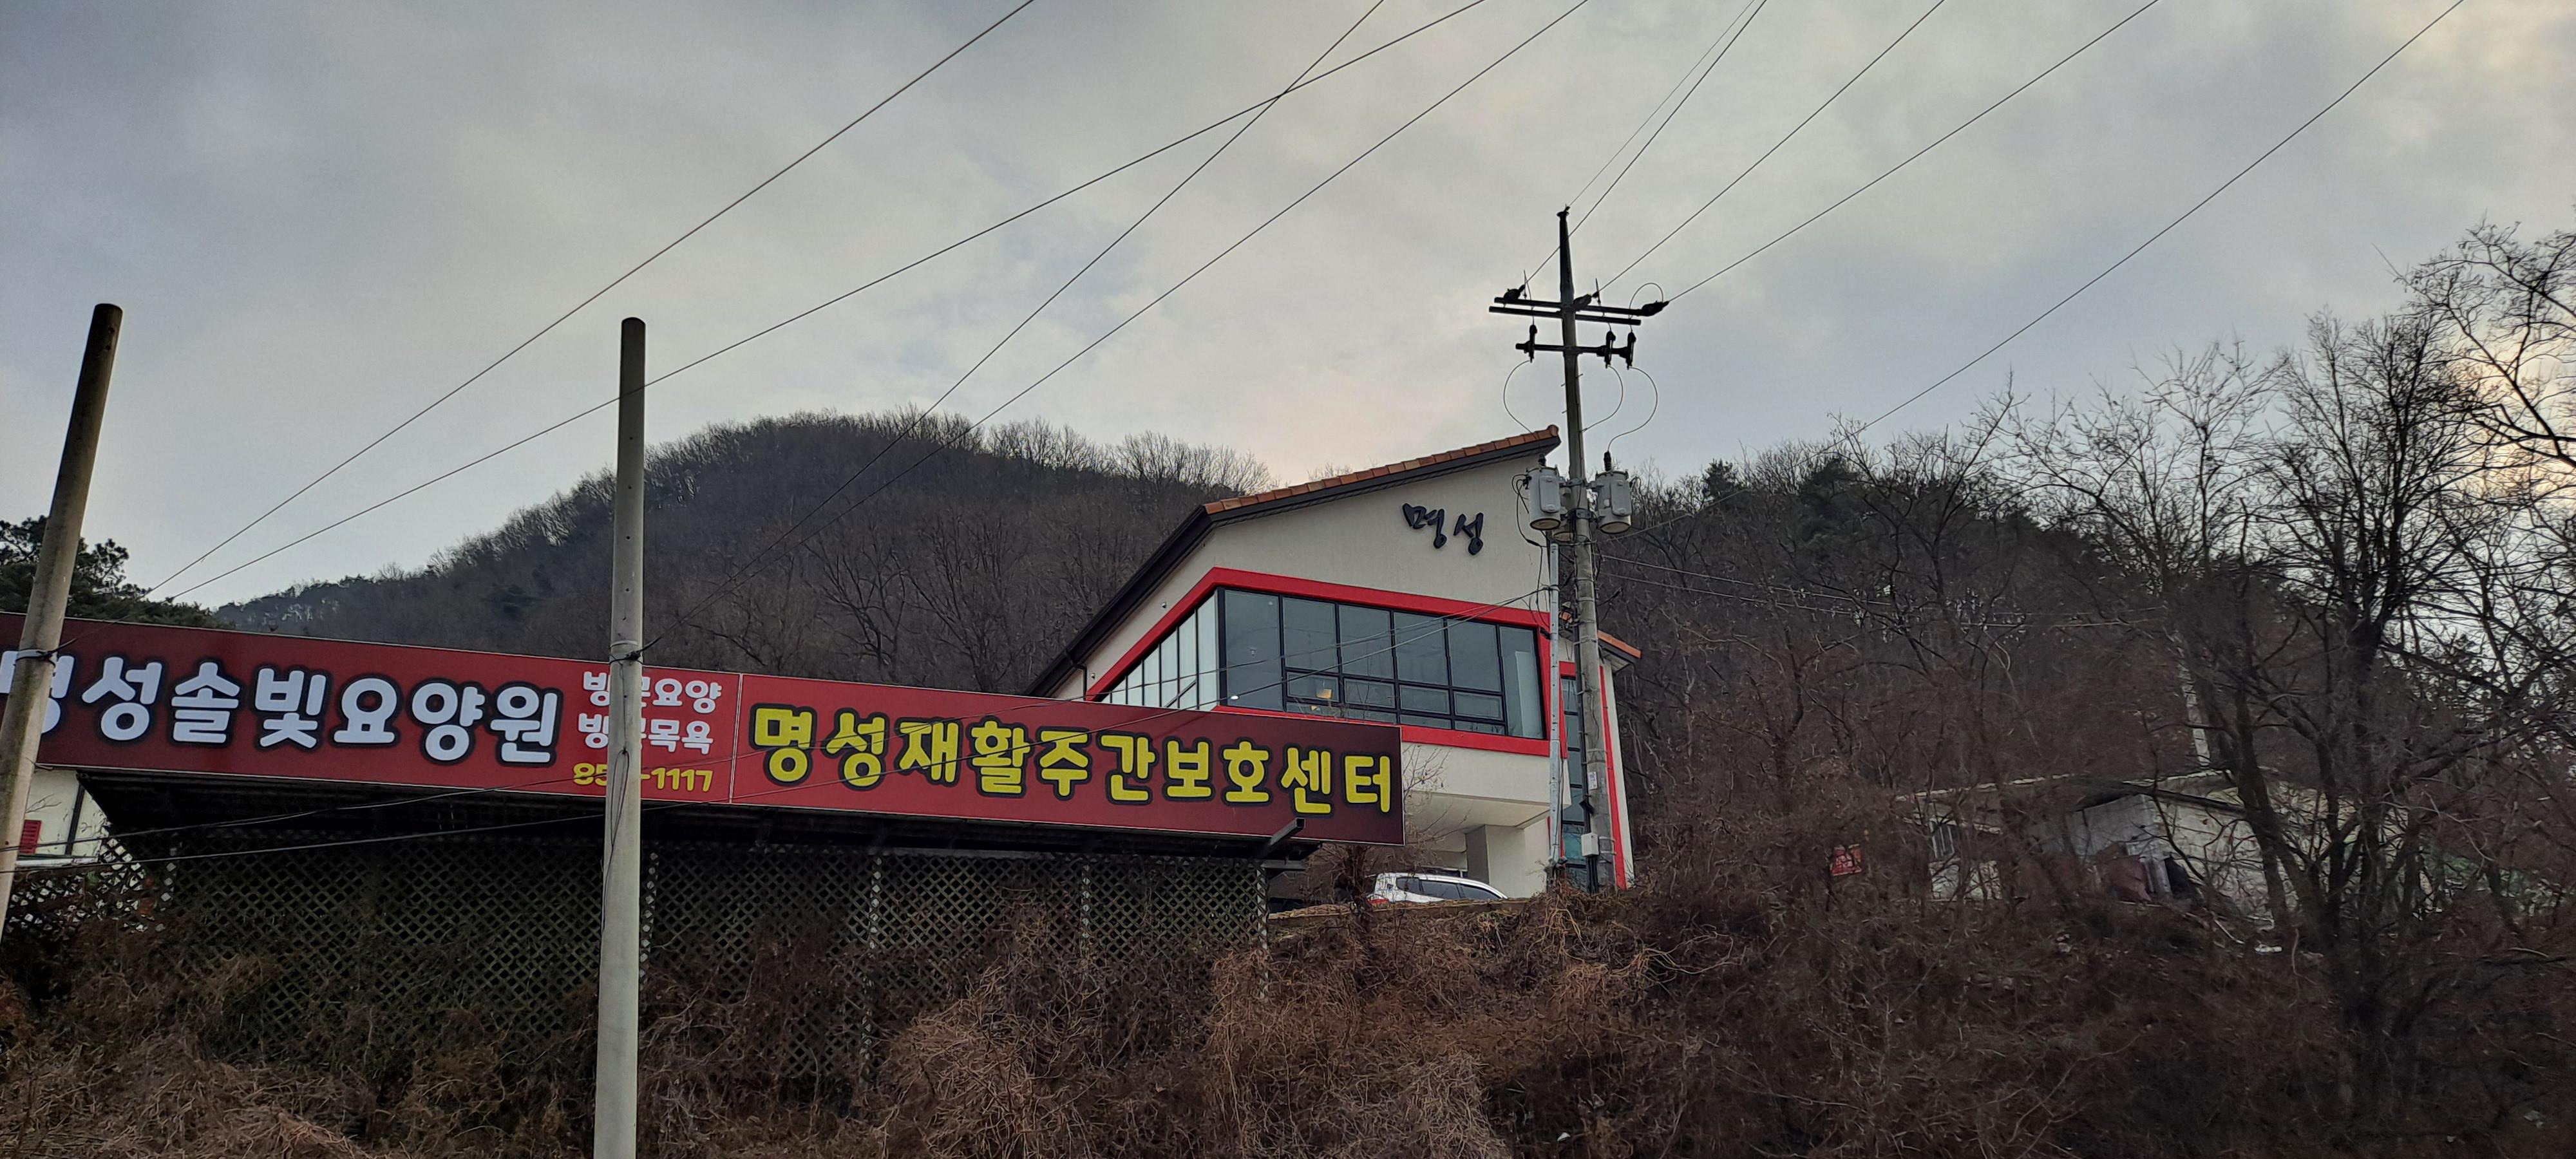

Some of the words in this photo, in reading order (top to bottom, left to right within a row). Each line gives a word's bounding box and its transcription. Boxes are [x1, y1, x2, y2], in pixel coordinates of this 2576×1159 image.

[1403, 503, 1484, 556] 명성
[583, 671, 723, 713] 방요양
[578, 713, 714, 755] 방목욕
[573, 762, 714, 792] 85-1117
[755, 707, 1392, 814] 명성재활주간보호센터
